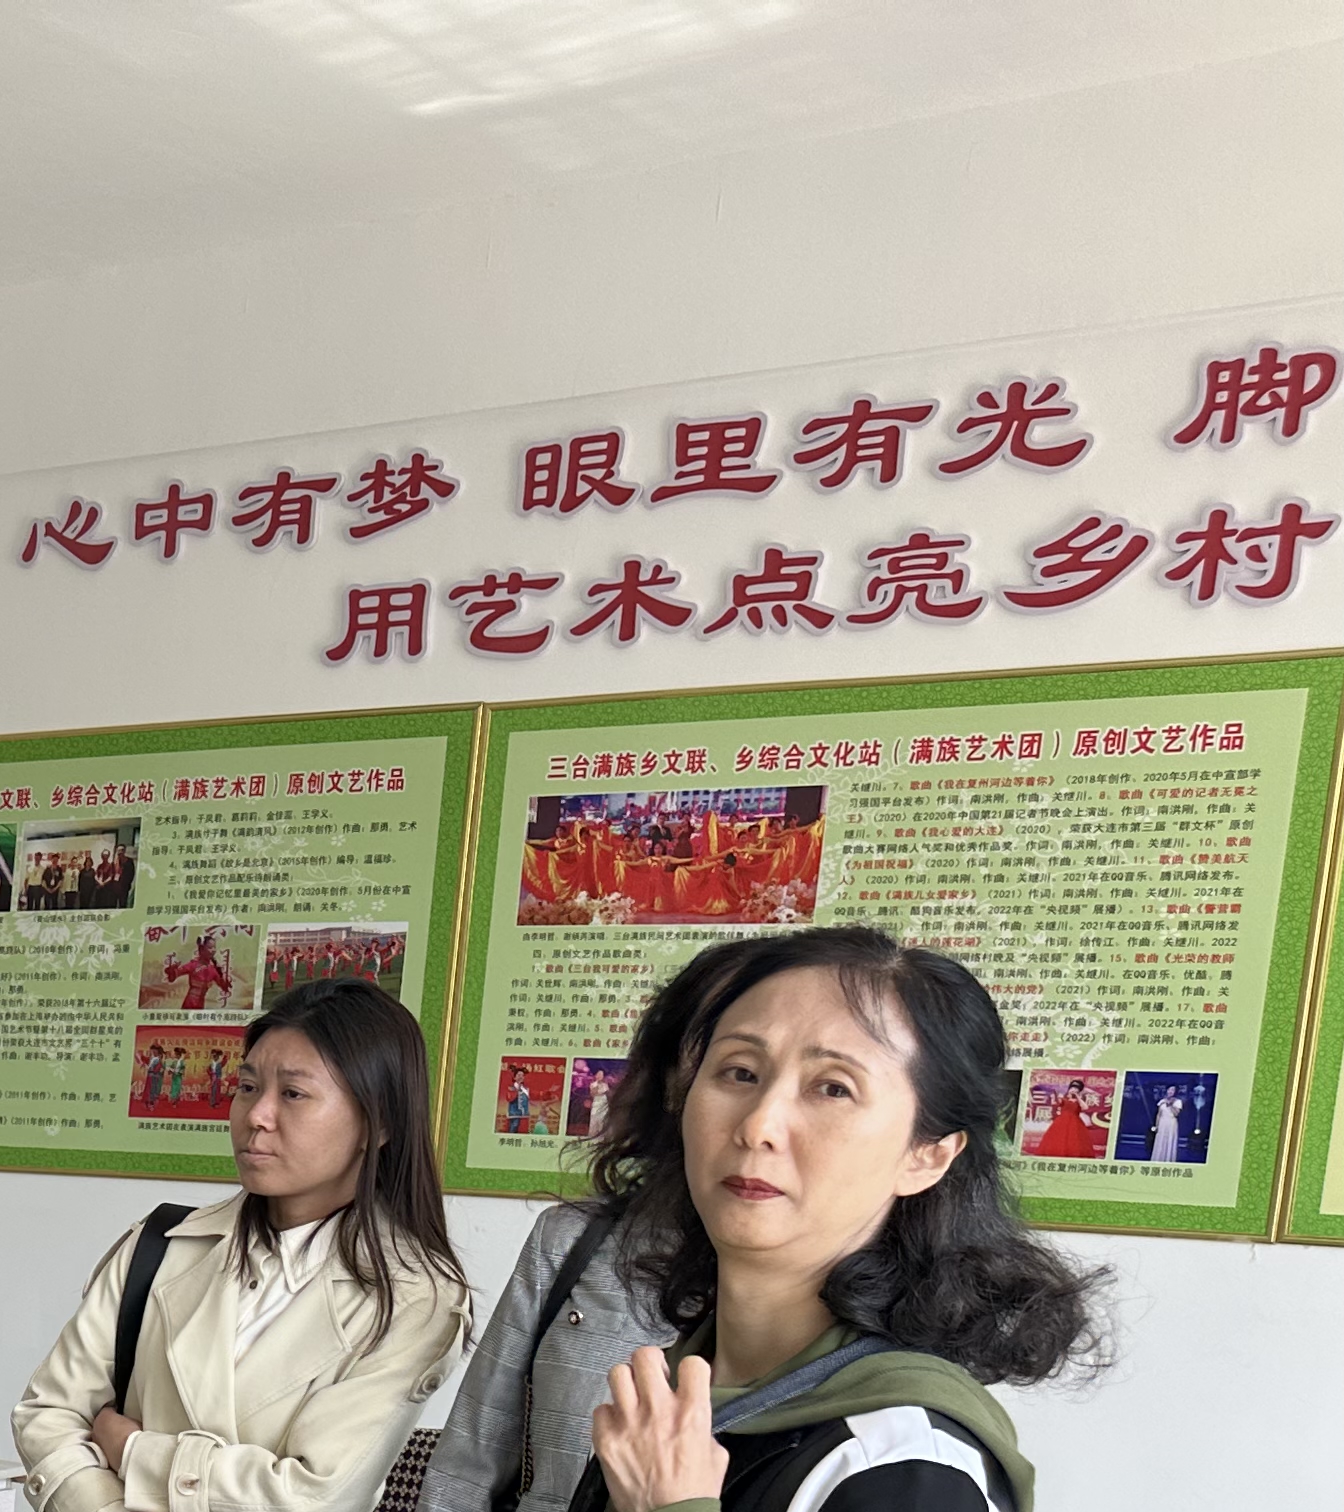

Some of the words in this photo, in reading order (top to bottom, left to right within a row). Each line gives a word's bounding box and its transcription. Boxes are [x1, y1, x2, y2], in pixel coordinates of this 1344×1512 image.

[20, 452, 460, 563] 心中有梦
[521, 376, 1088, 514] 眼里有光
[1173, 346, 1337, 445] 脚
[324, 502, 1336, 662] 用艺术点亮乡村
[546, 720, 1248, 781] 三台满族乡文联、乡综合文化站（满族艺术团）原创文艺作品
